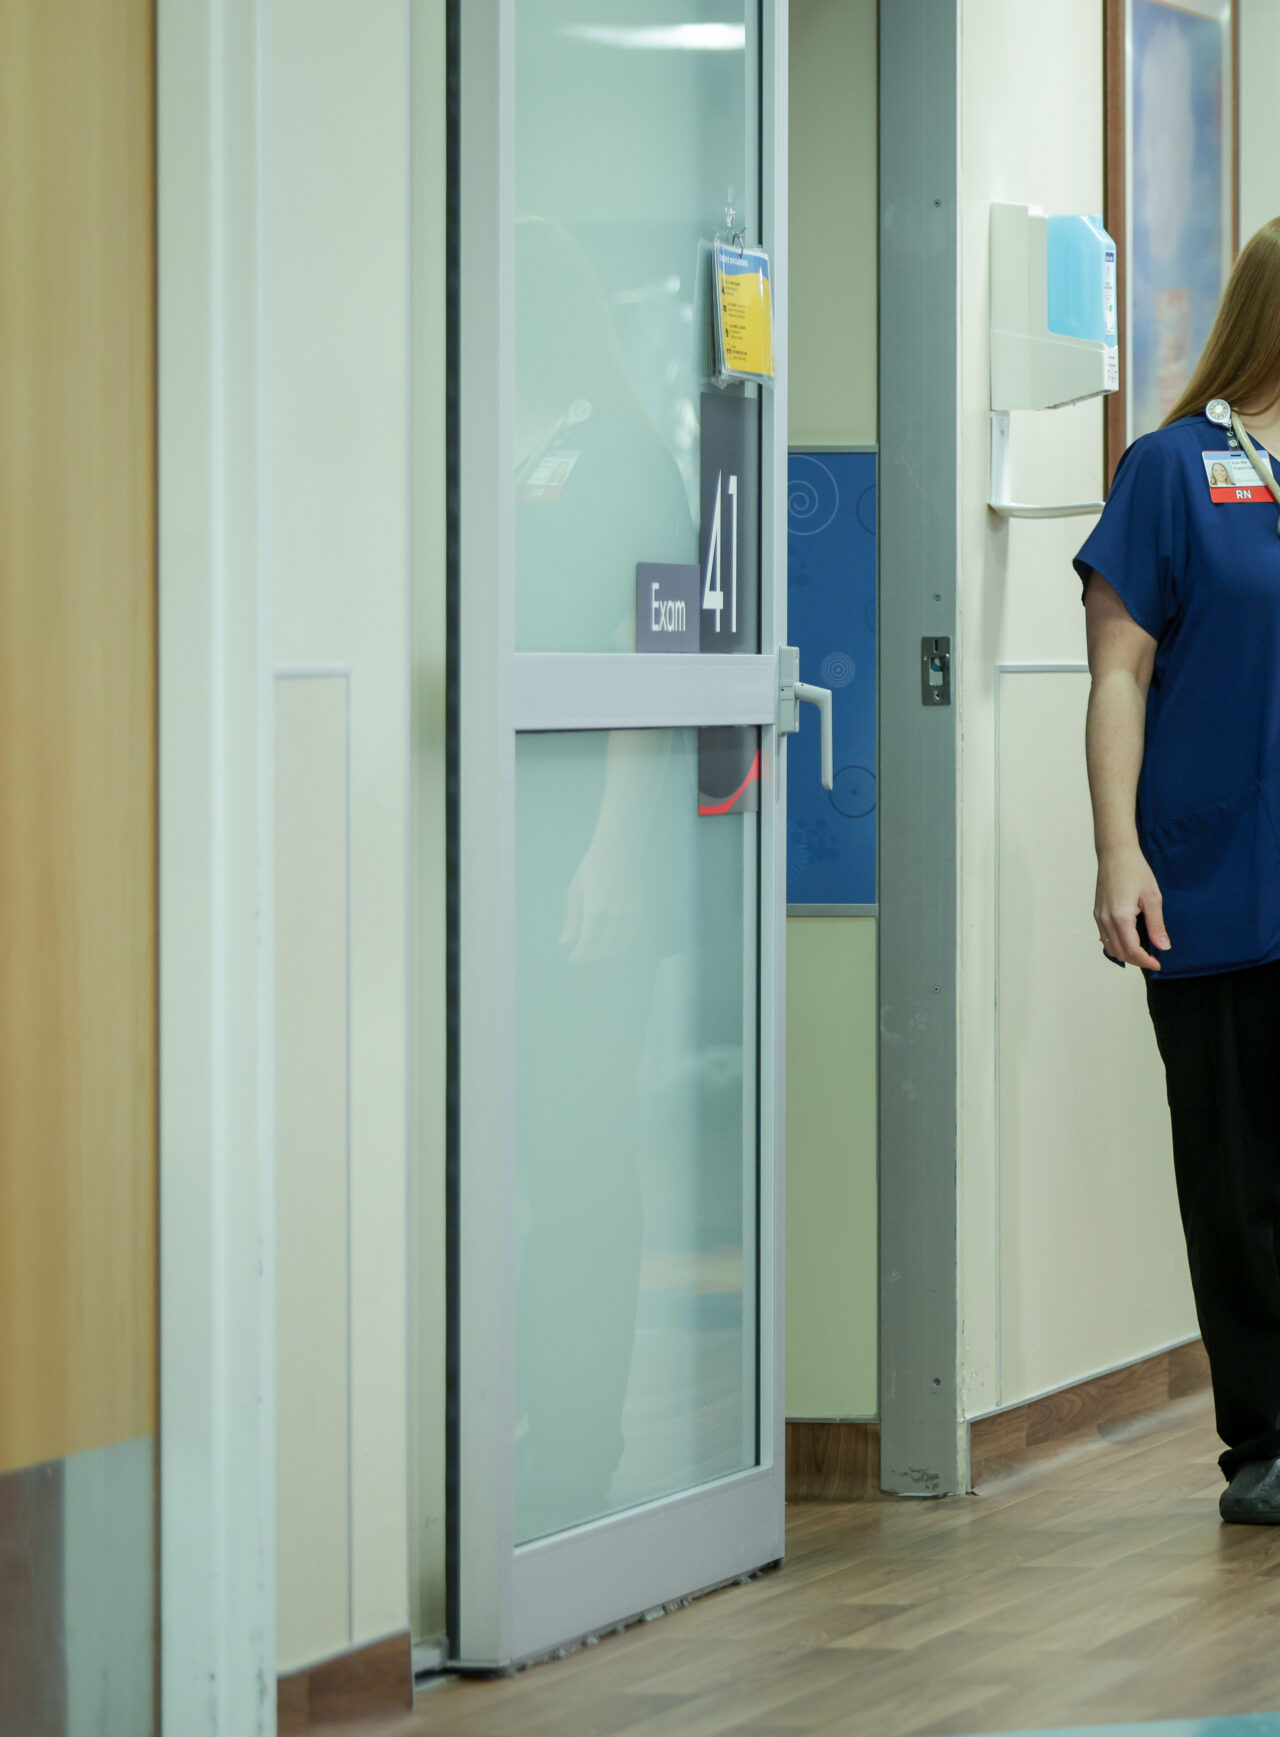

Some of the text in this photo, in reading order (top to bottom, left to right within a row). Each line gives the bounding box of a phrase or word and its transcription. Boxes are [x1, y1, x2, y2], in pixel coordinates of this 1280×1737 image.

[1235, 489, 1252, 499] RN
[702, 468, 738, 632] 41
[651, 582, 686, 632] Exam
